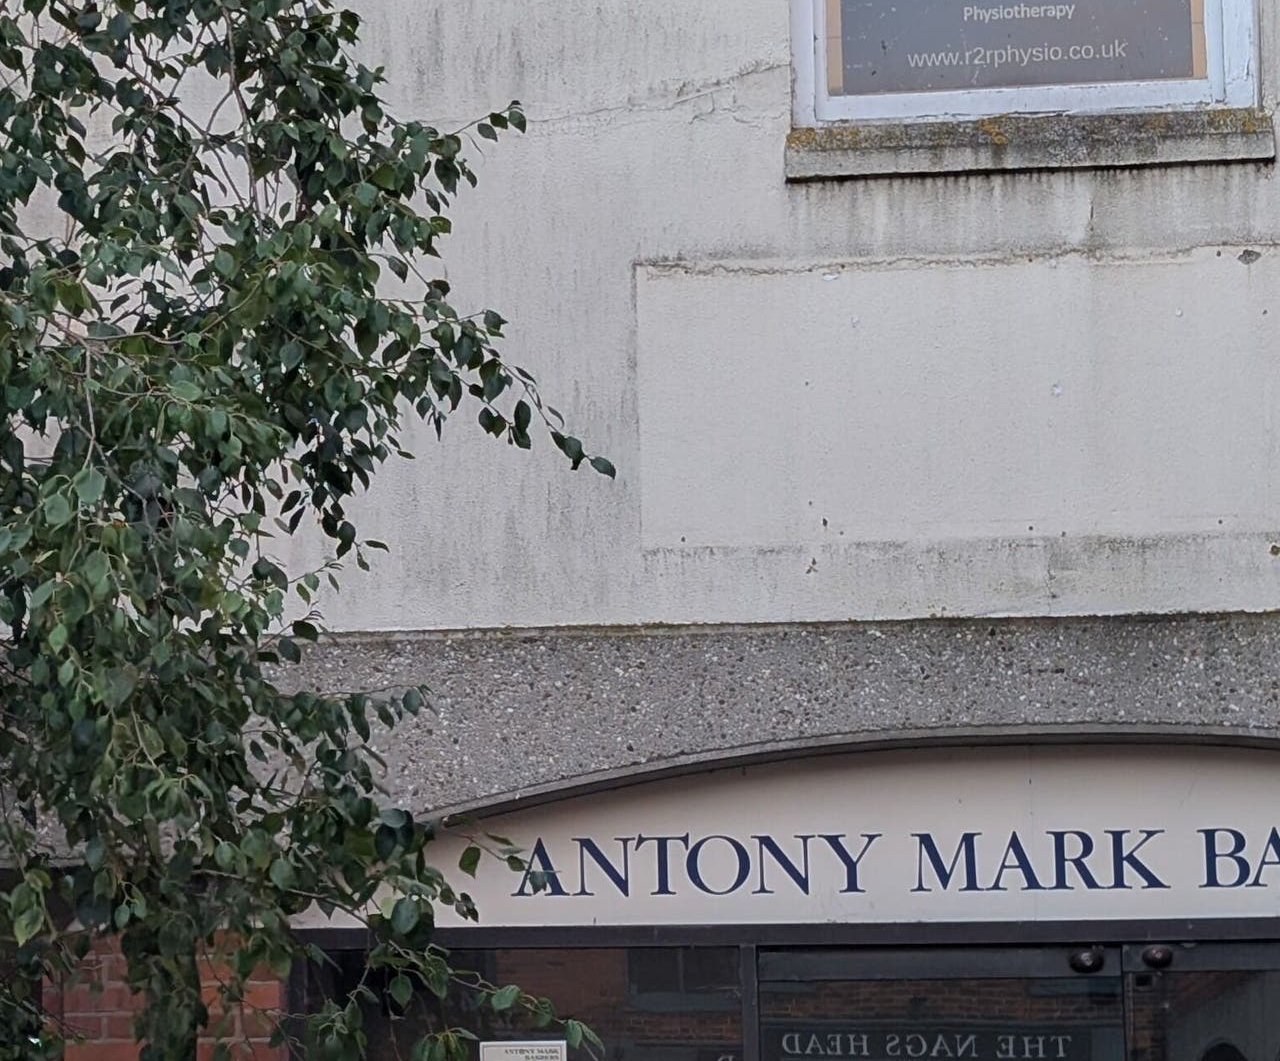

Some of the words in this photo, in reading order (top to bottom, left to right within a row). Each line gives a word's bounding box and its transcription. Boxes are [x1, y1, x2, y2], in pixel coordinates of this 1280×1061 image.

[964, 3, 1076, 23] Physiotherapy
[908, 40, 1128, 69] www.r2rphysio.co.uk
[511, 832, 882, 897] ANTONY
[911, 829, 1170, 892] MARK
